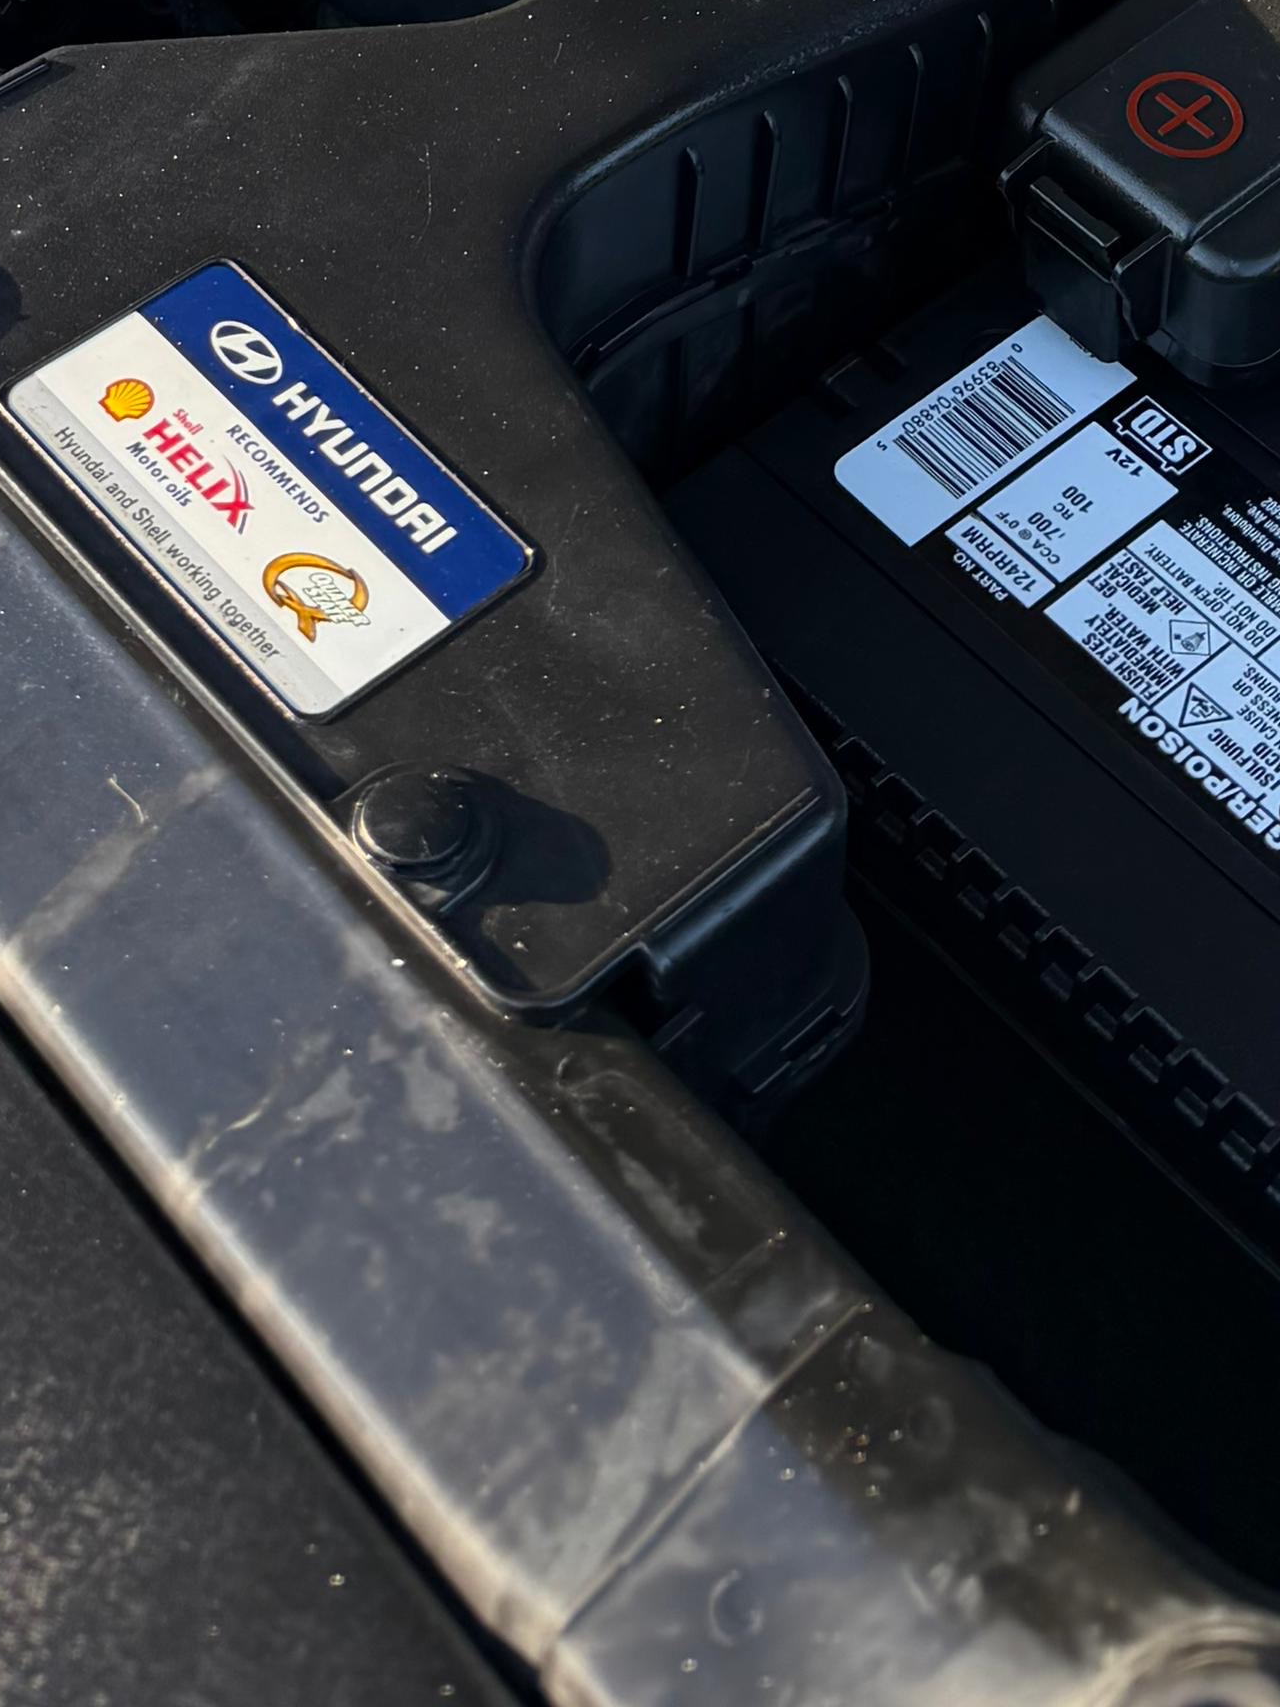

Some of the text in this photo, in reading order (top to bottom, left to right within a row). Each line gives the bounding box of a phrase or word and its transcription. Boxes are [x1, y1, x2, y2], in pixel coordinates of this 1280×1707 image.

[1009, 342, 1023, 354] 0
[951, 360, 1002, 400] 83996
[173, 408, 204, 435] Shell
[1130, 408, 1196, 462] STD
[126, 441, 193, 507] Motor oils
[143, 418, 254, 531] HELIX
[226, 425, 330, 525] RECOMMENDS
[273, 381, 458, 554] HYUNDAI
[1103, 447, 1143, 477] 12V
[1051, 501, 1074, 521] RC
[1061, 485, 1093, 513] 100
[55, 427, 280, 659] Hyundai and Shell working together
[1031, 537, 1061, 565] CCA
[1178, 519, 1241, 574] INCINERATE.
[1194, 514, 1272, 582] INSTRUCTIONS.
[1221, 503, 1274, 553] Distributors,
[952, 548, 1009, 601] PART NO.
[960, 525, 1036, 592] 124RPRM
[1116, 552, 1187, 616] HELP FAST.
[1235, 569, 1258, 588] OR
[1086, 573, 1118, 599] GET
[1102, 561, 1161, 615] MEDICAL
[1143, 542, 1265, 648] DO NOT OPEN BATTERY.
[1211, 580, 1277, 638] DO NOT TIP.
[1080, 631, 1160, 701] FLUSH EYES
[1083, 613, 1172, 690] IMMEDIATELY
[1103, 602, 1185, 680] WITH WATER.
[1231, 677, 1254, 697] OR
[1235, 703, 1278, 741] CAUSE
[1206, 727, 1275, 787] SULFURIC
